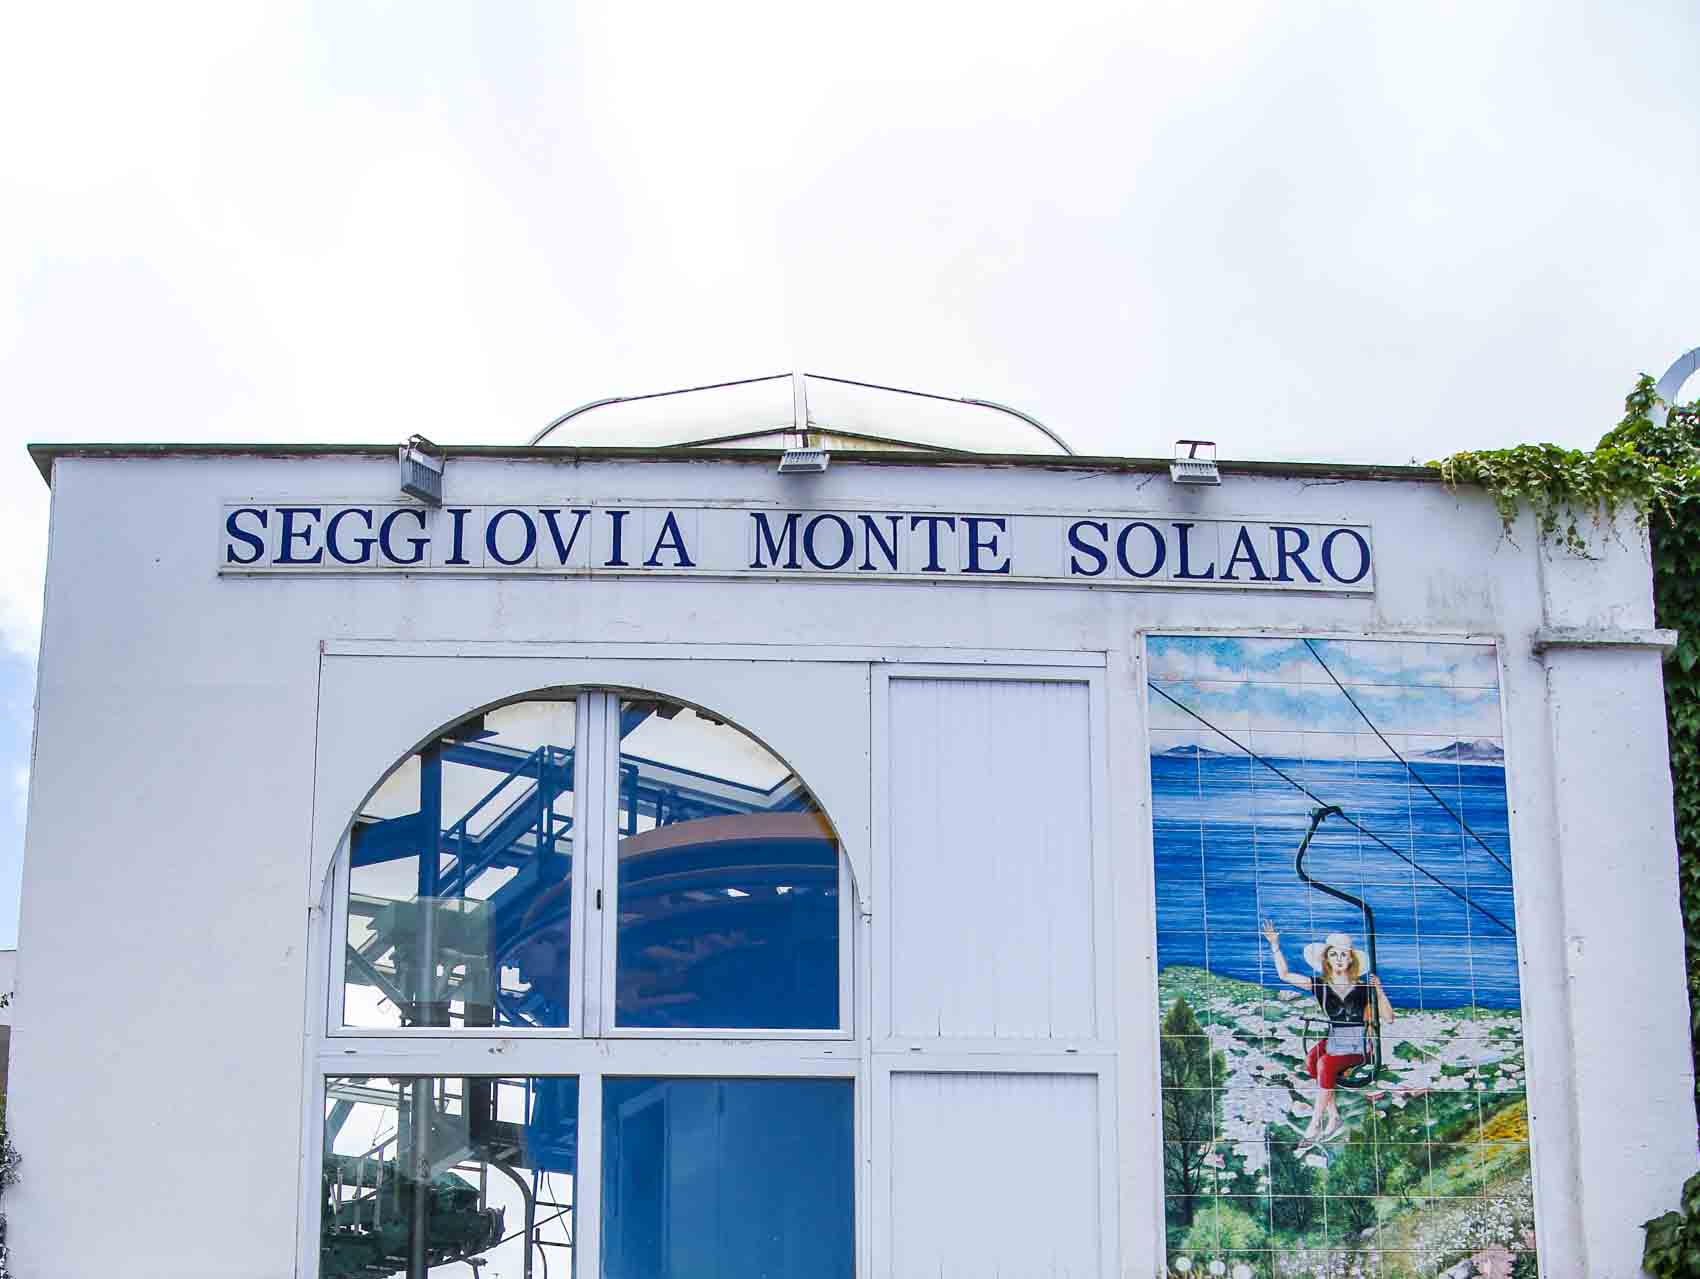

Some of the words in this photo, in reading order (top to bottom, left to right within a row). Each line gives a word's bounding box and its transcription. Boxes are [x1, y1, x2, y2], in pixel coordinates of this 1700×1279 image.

[225, 508, 697, 568] SEGGIOVIA
[748, 512, 1011, 574] MONTE
[1067, 519, 1372, 585] SOLARO
